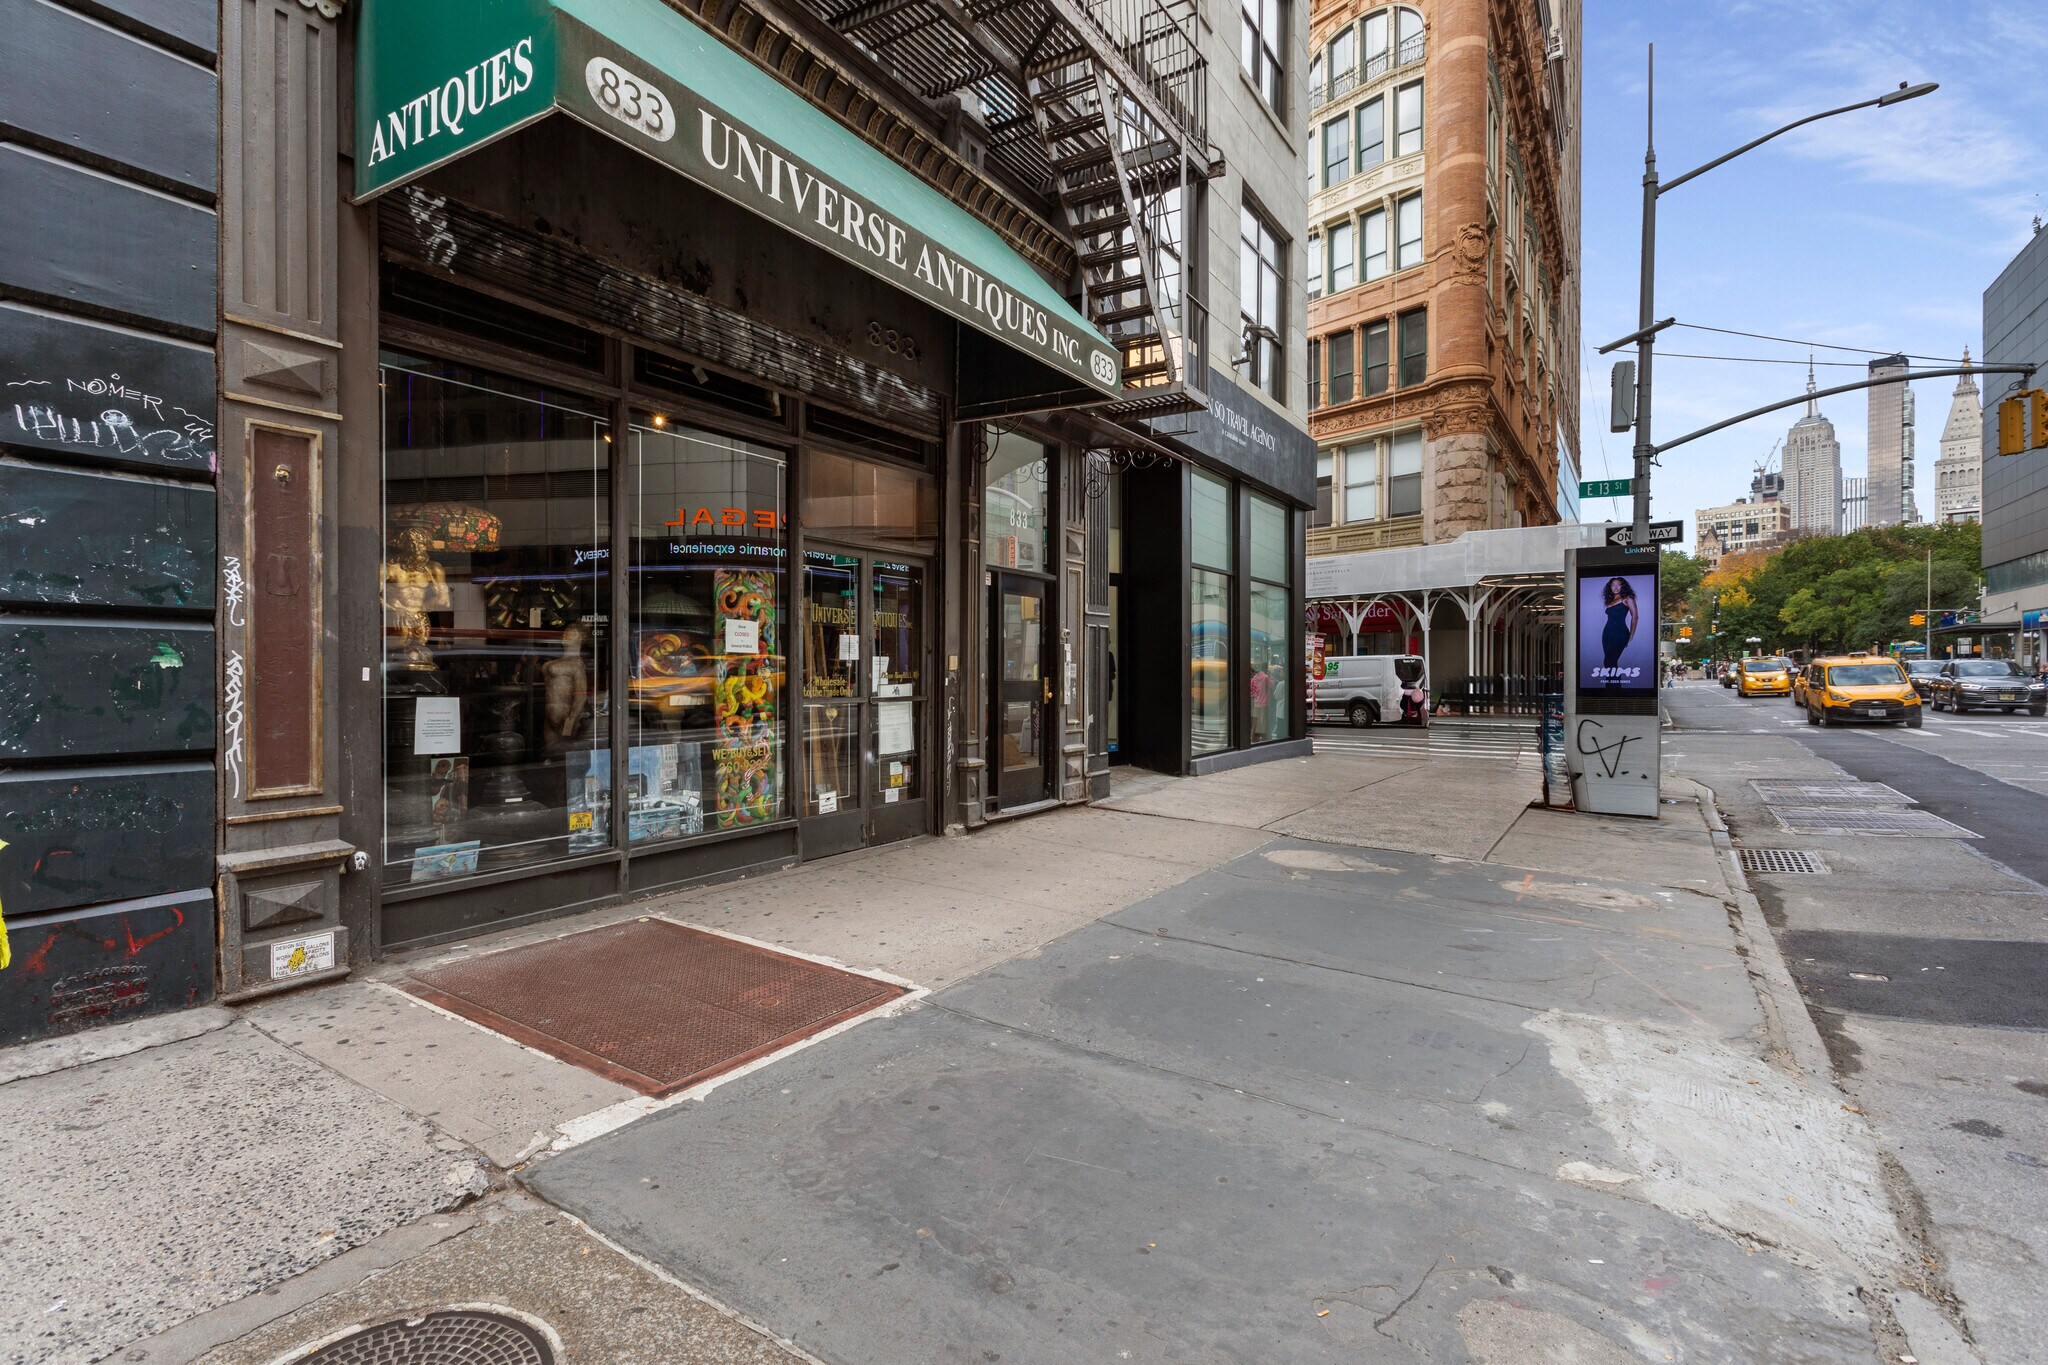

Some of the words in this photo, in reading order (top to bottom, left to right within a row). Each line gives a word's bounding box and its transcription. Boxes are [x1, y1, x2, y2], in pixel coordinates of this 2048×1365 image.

[368, 36, 533, 167] ANTIQUES
[599, 67, 664, 133] 833
[698, 108, 907, 271] UNIVERSE
[913, 243, 1048, 347] ANTIQUES
[1052, 330, 1083, 367] INC.
[1094, 353, 1115, 382] 833
[867, 320, 917, 362] 833
[1214, 400, 1225, 424] SQ
[1226, 407, 1249, 437] TRAVEL
[1250, 424, 1276, 452] AGENCY
[1587, 483, 1593, 496] E
[1599, 482, 1610, 495] 13
[1614, 481, 1623, 490] St
[1009, 509, 1028, 529] 833
[1617, 532, 1632, 542] ON
[1649, 528, 1673, 539] WAY
[1624, 546, 1656, 554] LinkNYC
[812, 603, 855, 625] UNIVERSE
[1591, 667, 1641, 678] SKIMS
[712, 748, 727, 761] WE
[275, 943, 295, 952] DESIGN
[295, 940, 306, 948] SIZE
[306, 941, 330, 950] GALLONS
